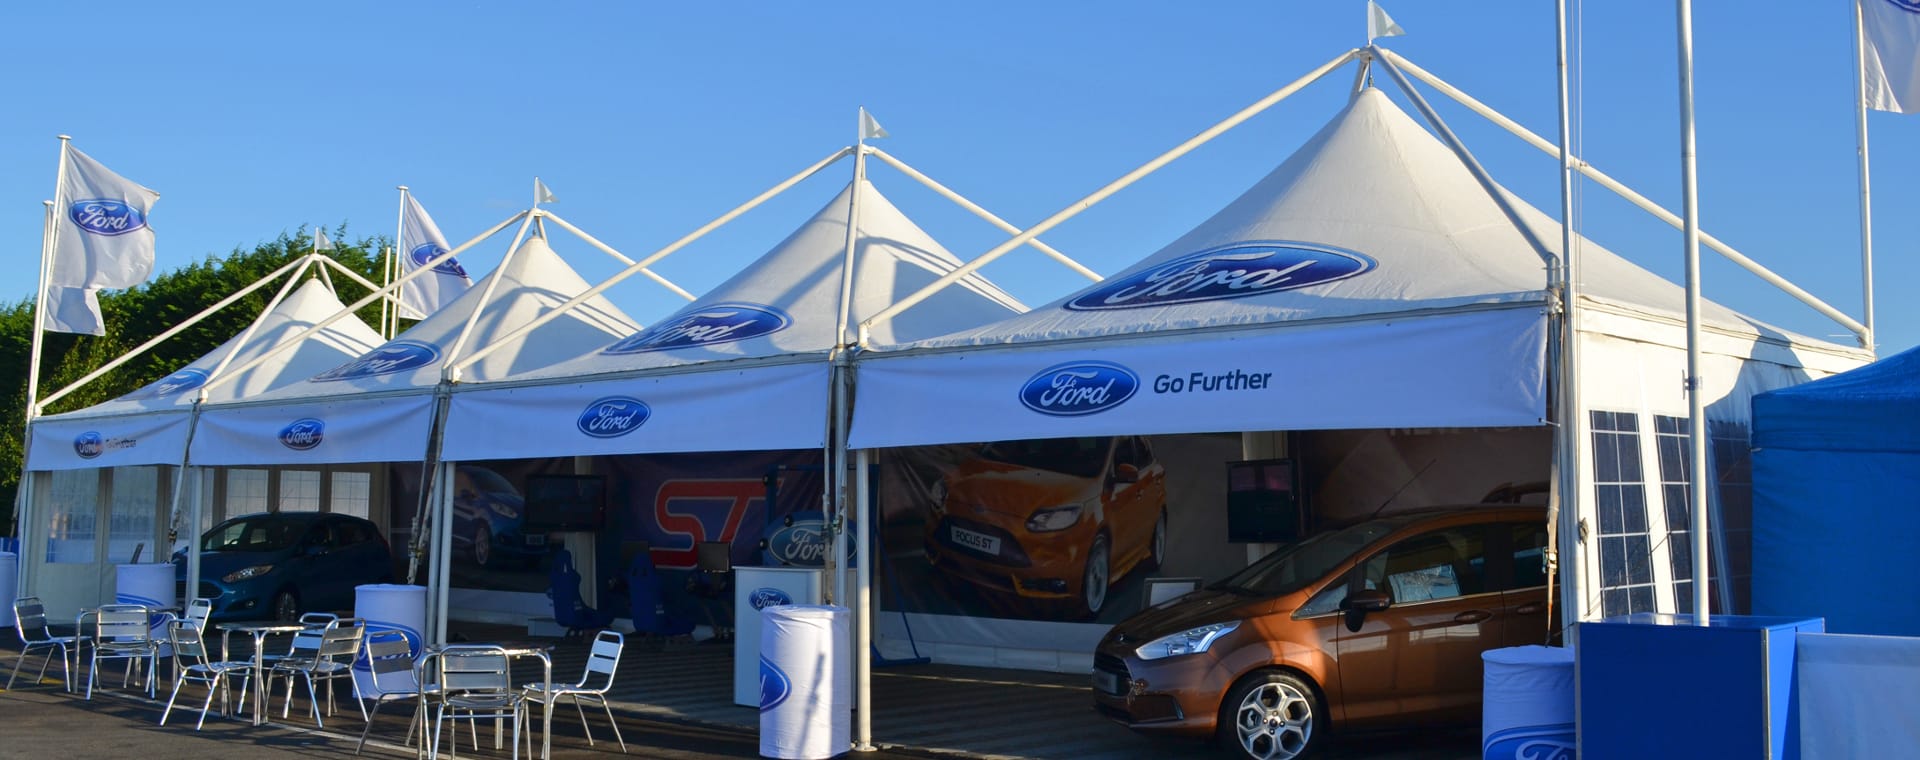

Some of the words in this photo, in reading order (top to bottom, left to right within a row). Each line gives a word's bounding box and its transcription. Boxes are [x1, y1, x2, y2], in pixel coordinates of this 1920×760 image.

[78, 203, 130, 230] Ford
[1103, 251, 1318, 304] Ford
[1040, 370, 1116, 407] Ford
[1153, 374, 1184, 394] Go
[1188, 369, 1272, 393] Further
[589, 403, 638, 431] Ford
[286, 423, 316, 444] Ford
[649, 478, 786, 570] ST
[955, 530, 981, 548] FOCUS
[981, 537, 993, 550] ST
